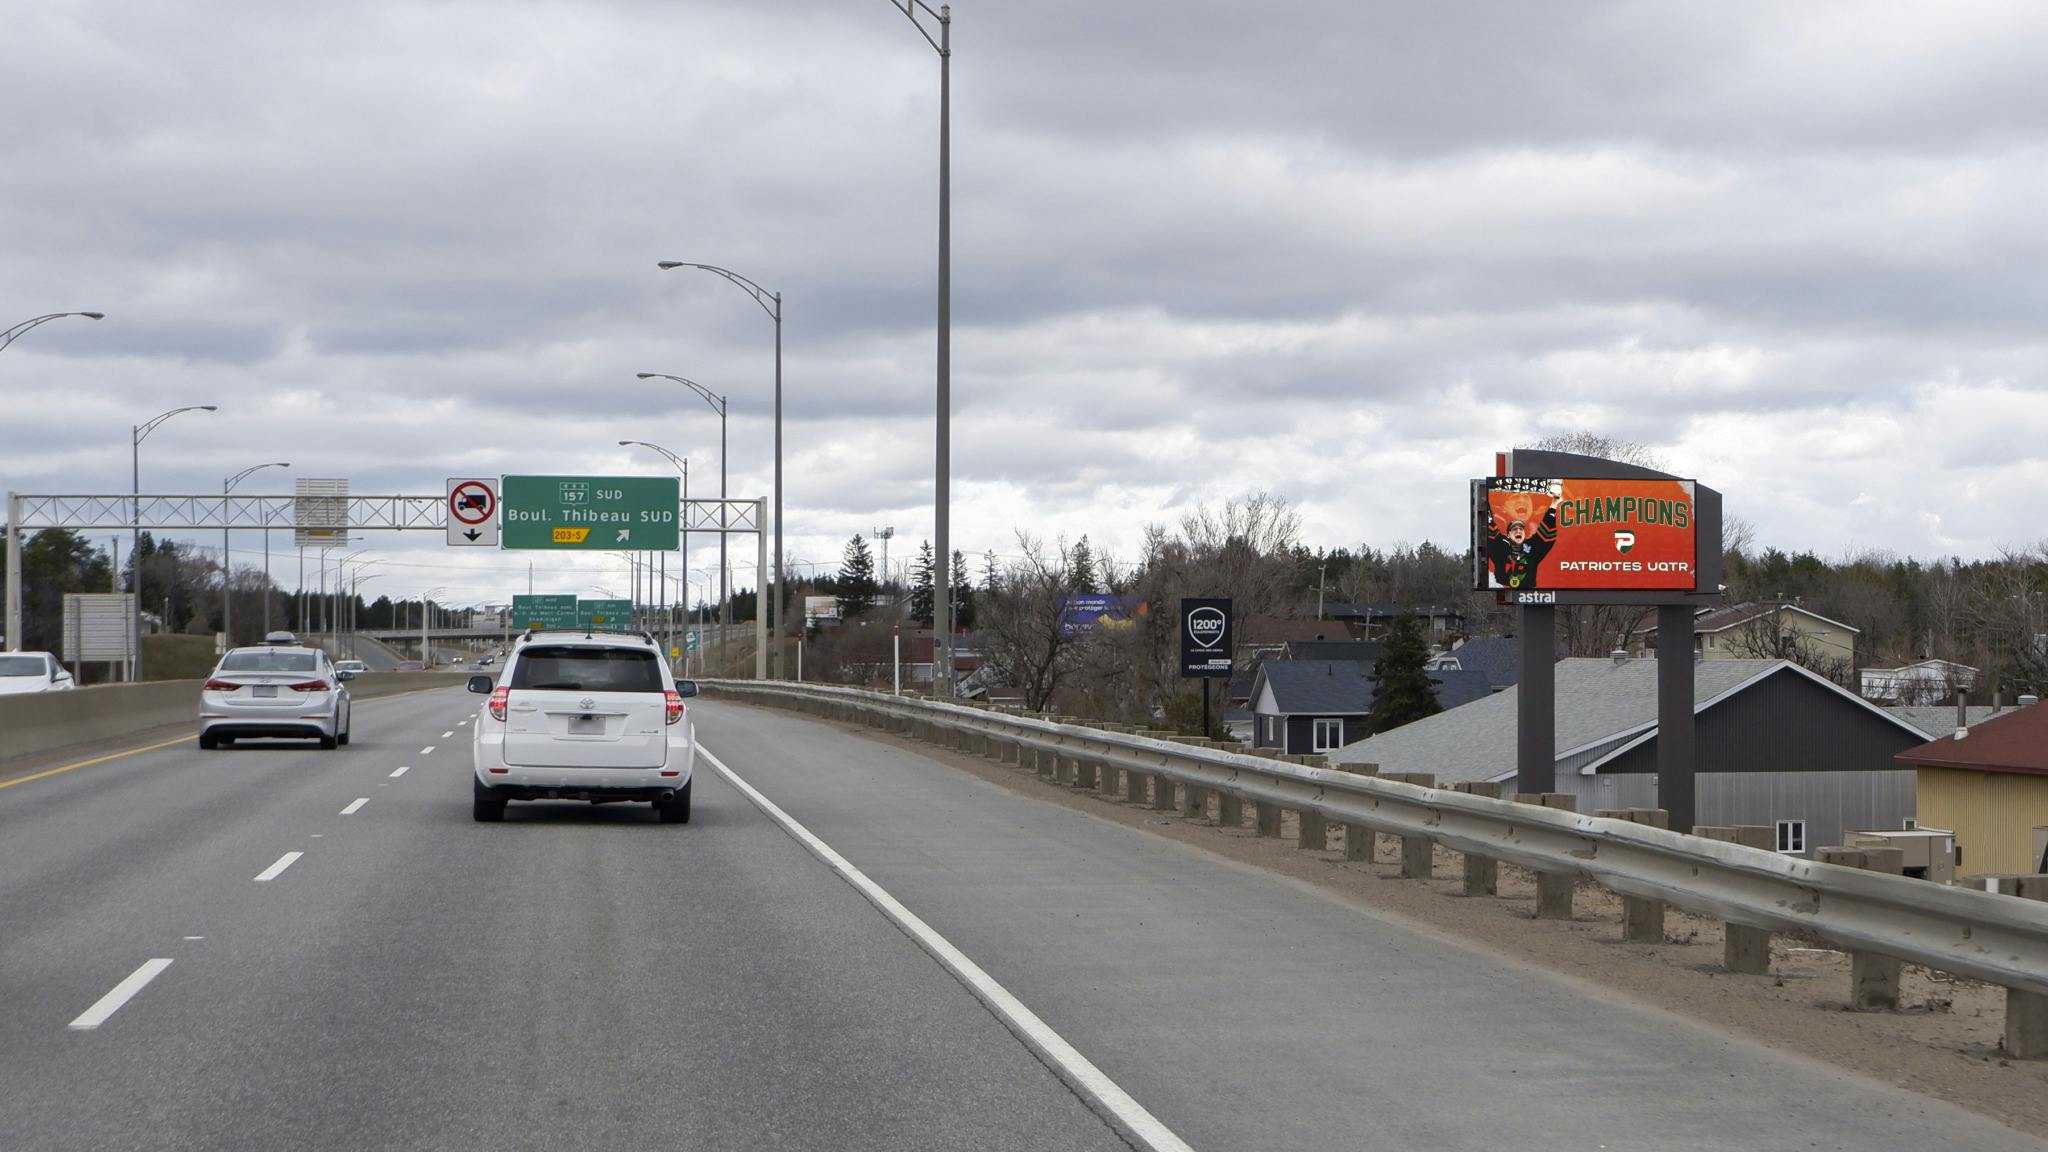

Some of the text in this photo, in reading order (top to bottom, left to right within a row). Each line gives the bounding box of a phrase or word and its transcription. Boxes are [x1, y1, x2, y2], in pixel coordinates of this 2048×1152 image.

[564, 489, 623, 501] 157 SUD
[508, 509, 673, 523] Boul. Thibeau SUD
[1560, 496, 1689, 528] CHAMPIONS
[554, 530, 581, 540] 203-S
[1560, 561, 1688, 572] PATRIOTES UQTR
[1518, 591, 1556, 603] astral
[1193, 619, 1222, 630] 1200°
